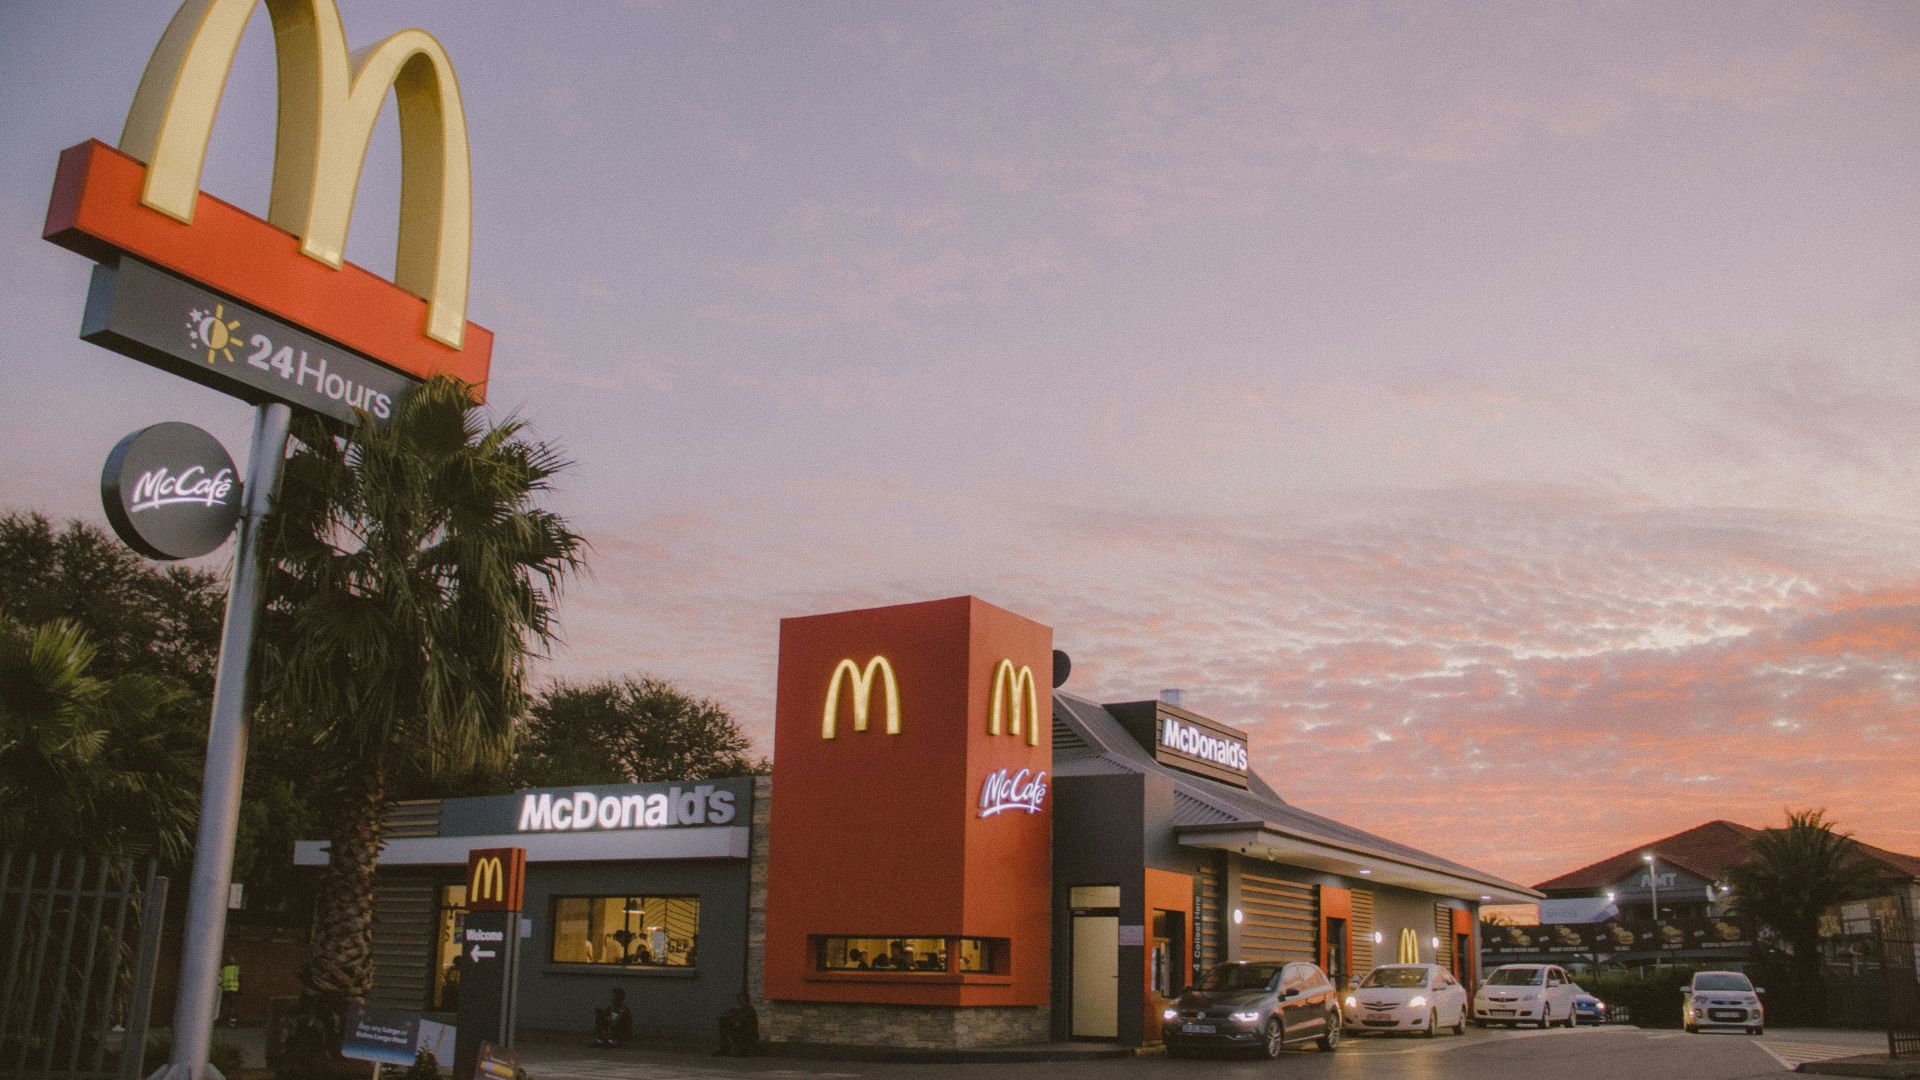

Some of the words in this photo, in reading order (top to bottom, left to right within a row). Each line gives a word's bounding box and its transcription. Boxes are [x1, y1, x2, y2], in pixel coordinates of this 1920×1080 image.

[247, 333, 295, 379] 24
[296, 350, 392, 420] Hours
[1161, 717, 1249, 771] McDonald's
[518, 785, 736, 831] McDonald's
[466, 928, 504, 941] Welcome
